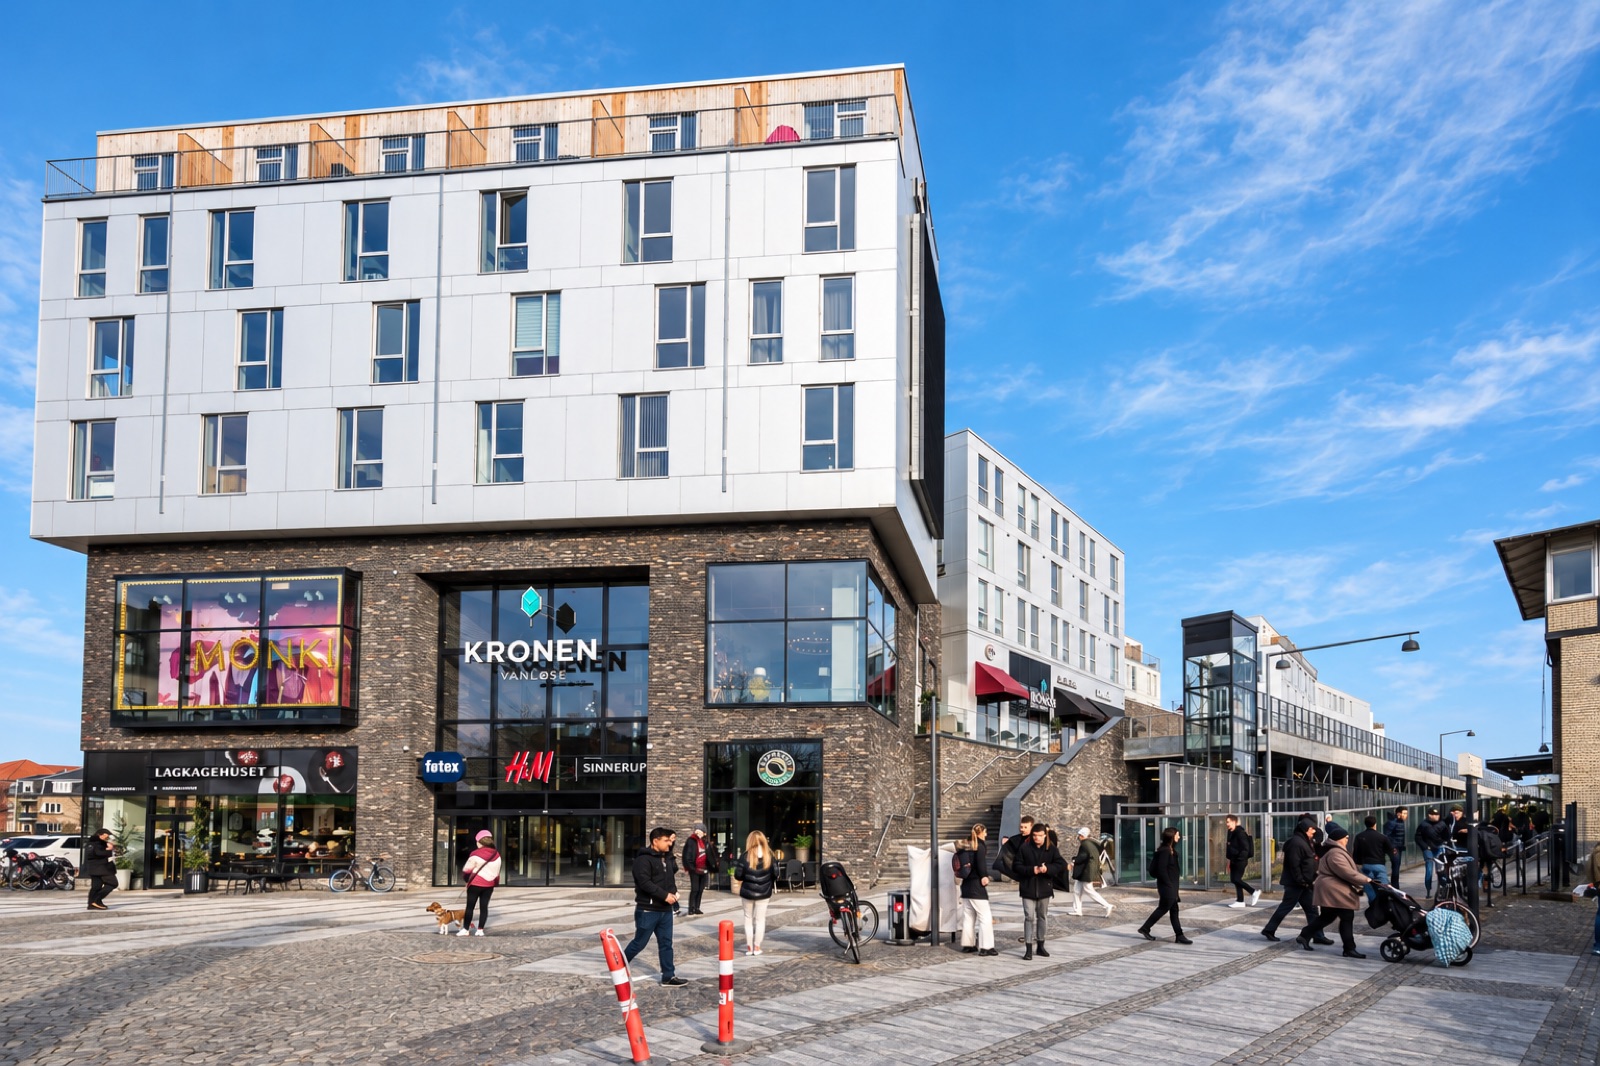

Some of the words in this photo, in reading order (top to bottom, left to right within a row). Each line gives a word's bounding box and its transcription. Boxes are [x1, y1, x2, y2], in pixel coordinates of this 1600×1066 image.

[194, 638, 335, 673] MONKI
[464, 638, 597, 663] KRONEN
[155, 766, 266, 778] LAGKAGEHUSET
[504, 751, 554, 784] H&M
[583, 762, 647, 773] SINNERUP
